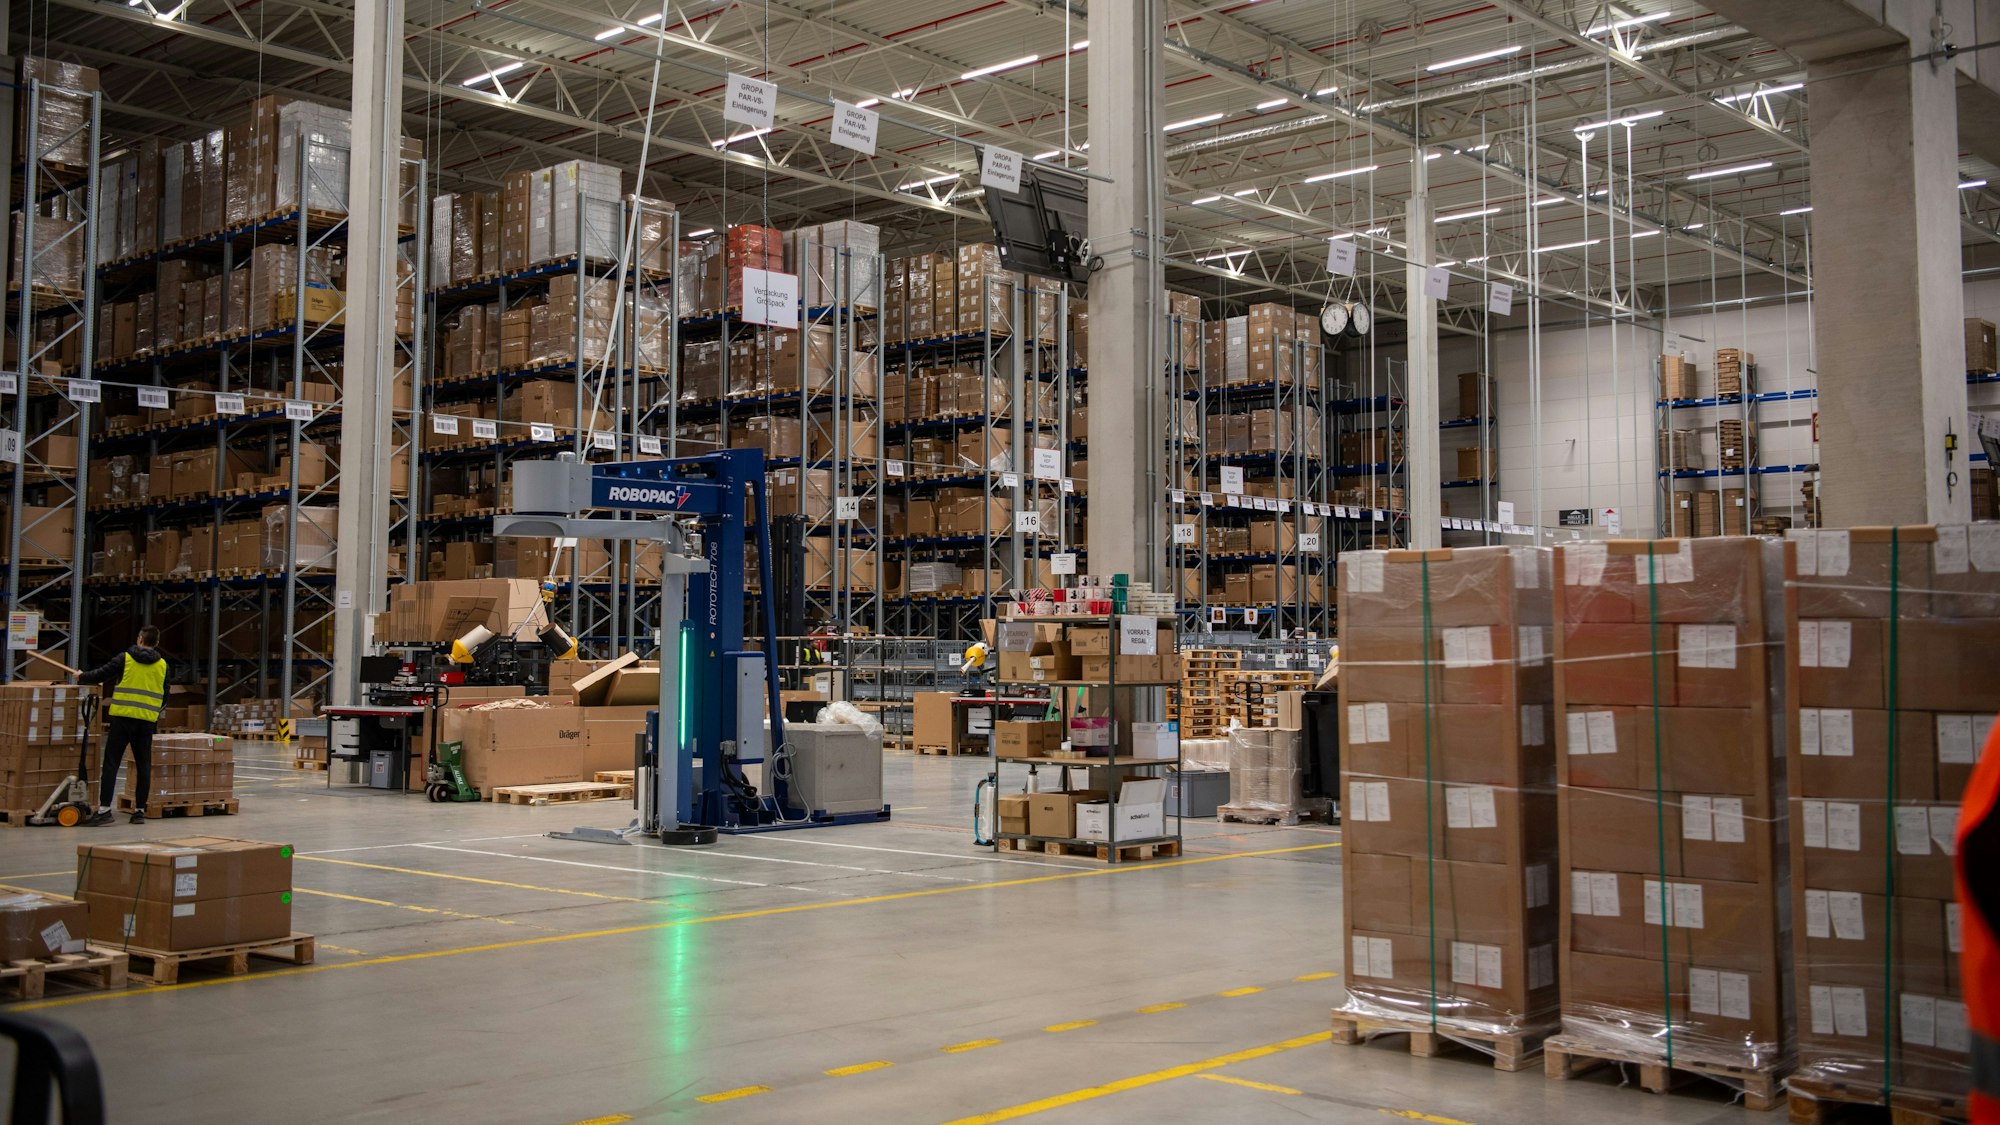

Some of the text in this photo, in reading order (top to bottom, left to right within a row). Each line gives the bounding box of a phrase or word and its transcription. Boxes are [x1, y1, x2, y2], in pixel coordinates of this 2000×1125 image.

[741, 83, 764, 96] GROPA
[738, 92, 764, 104] PAR-VS-
[732, 101, 768, 118] Einlagerung
[846, 110, 867, 122] GROPA
[844, 119, 867, 131] PAR-VS-
[838, 126, 871, 144] Einlagerung
[994, 152, 1012, 162] GROPA
[987, 168, 1016, 183] Einlagerung
[8, 437, 16, 452] 09
[609, 486, 676, 504] ROBOPAC
[845, 501, 856, 511] 14
[1025, 516, 1037, 526] 16
[1181, 528, 1192, 537] 18
[1306, 537, 1317, 546] 20
[709, 541, 718, 626] ROTOTECH 708
[559, 729, 580, 740] Dräger
